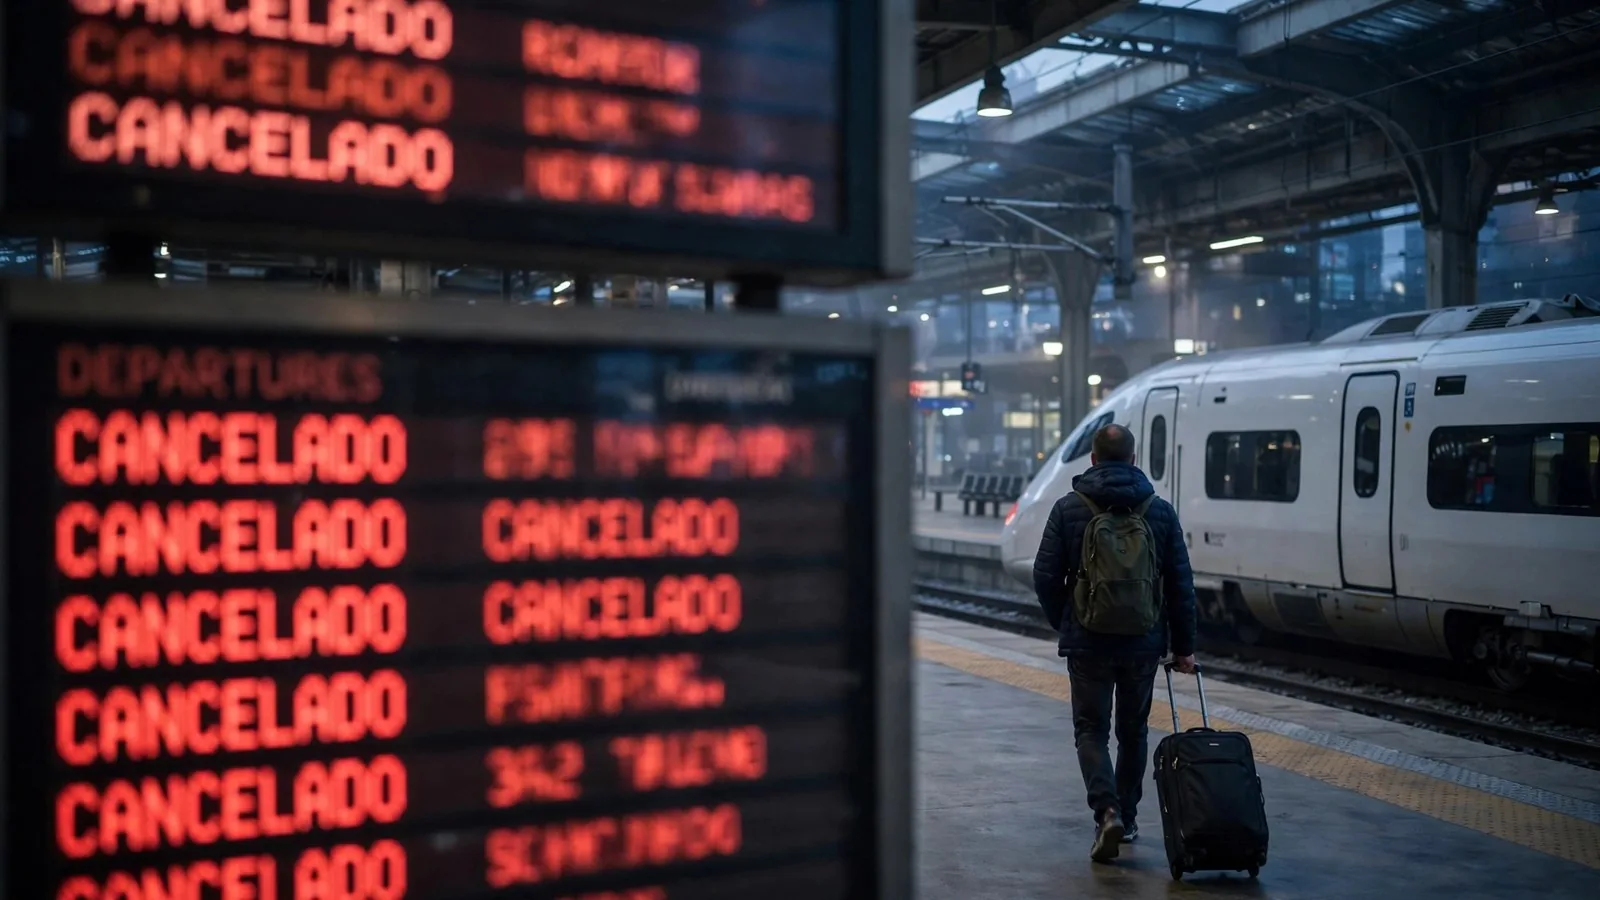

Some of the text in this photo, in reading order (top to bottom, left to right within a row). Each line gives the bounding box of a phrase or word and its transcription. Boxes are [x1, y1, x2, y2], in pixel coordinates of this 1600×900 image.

[74, 0, 453, 60] CELADO
[69, 20, 452, 122] CANCELADO
[69, 91, 453, 192] CANCELADO
[59, 345, 381, 402] DEPARTURES
[55, 408, 407, 486] CANCELADO
[55, 498, 407, 579] CANCELADO
[482, 498, 739, 562] CANCELADO
[55, 582, 407, 673] CANCELADO
[483, 573, 741, 644] CANCELADO
[55, 668, 407, 766] CANCELADO
[55, 754, 407, 859] CANCELADO
